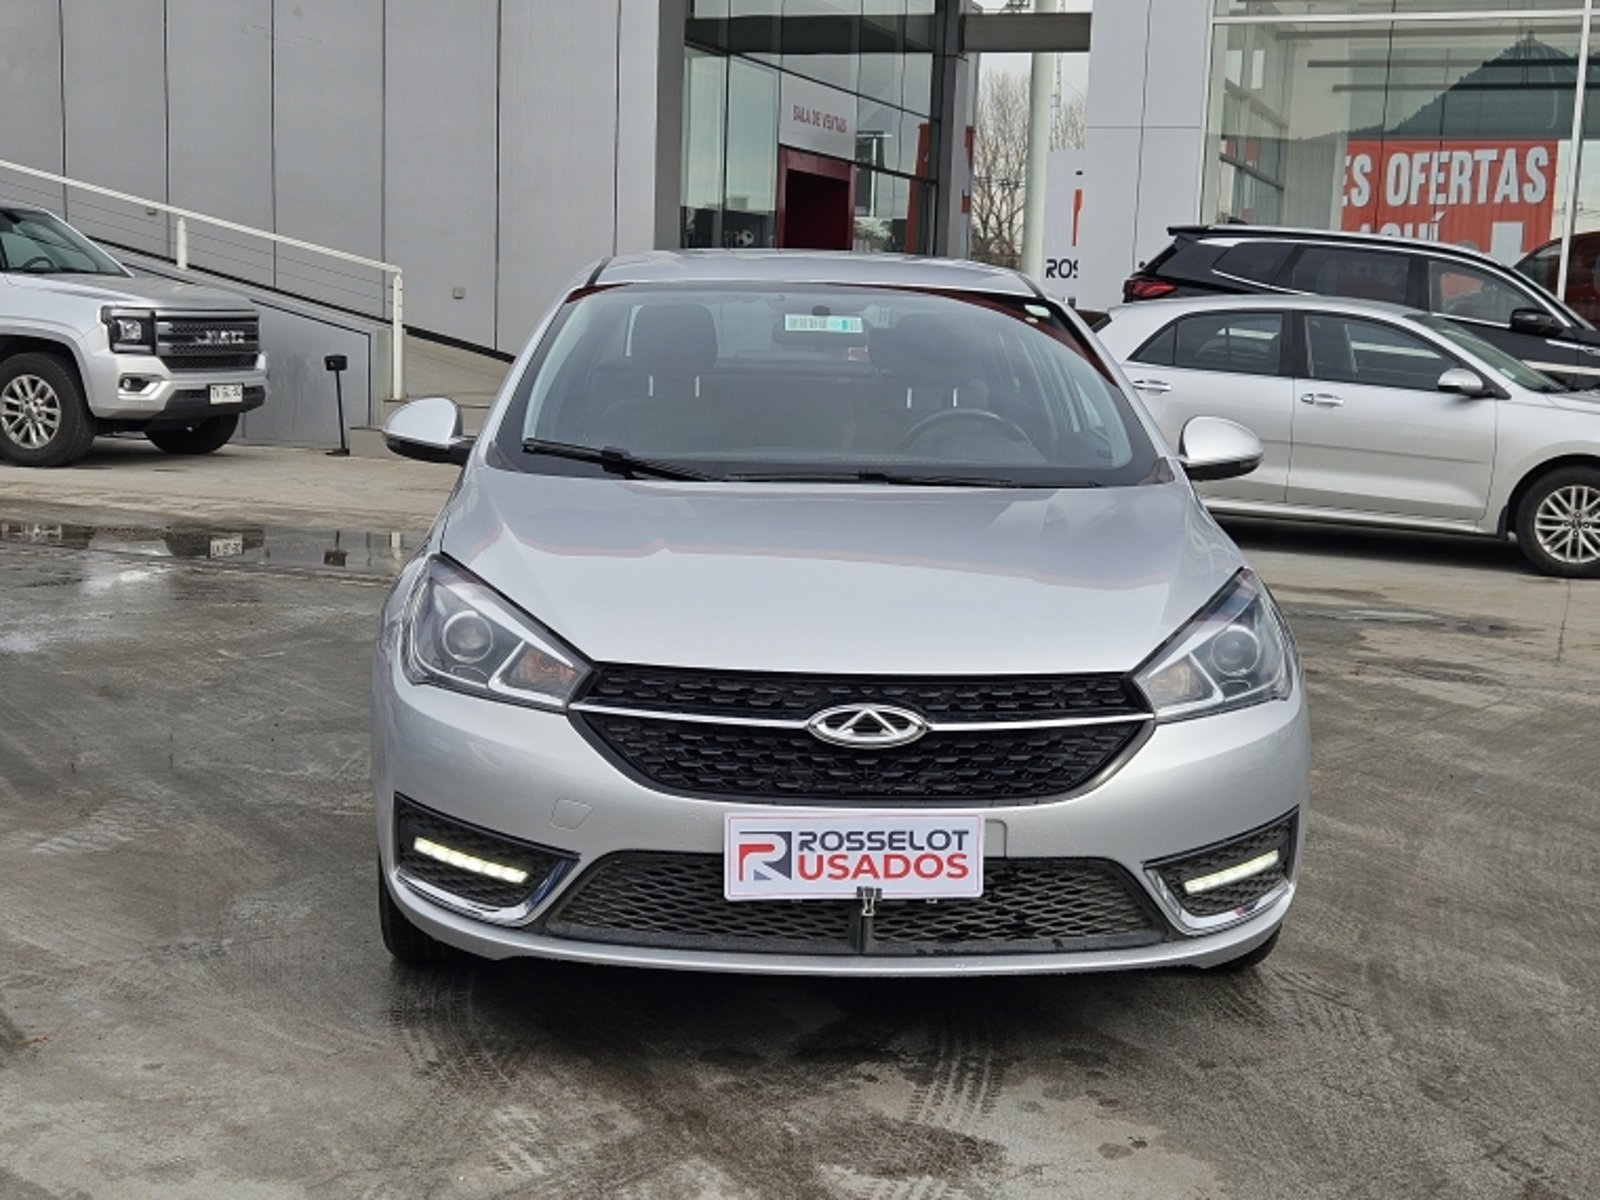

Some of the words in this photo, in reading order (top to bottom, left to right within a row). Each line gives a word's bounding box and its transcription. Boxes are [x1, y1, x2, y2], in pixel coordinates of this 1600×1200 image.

[1386, 146, 1549, 208] OFERTAS
[798, 829, 970, 852] ROSSELOT
[796, 853, 970, 882] USADOS
